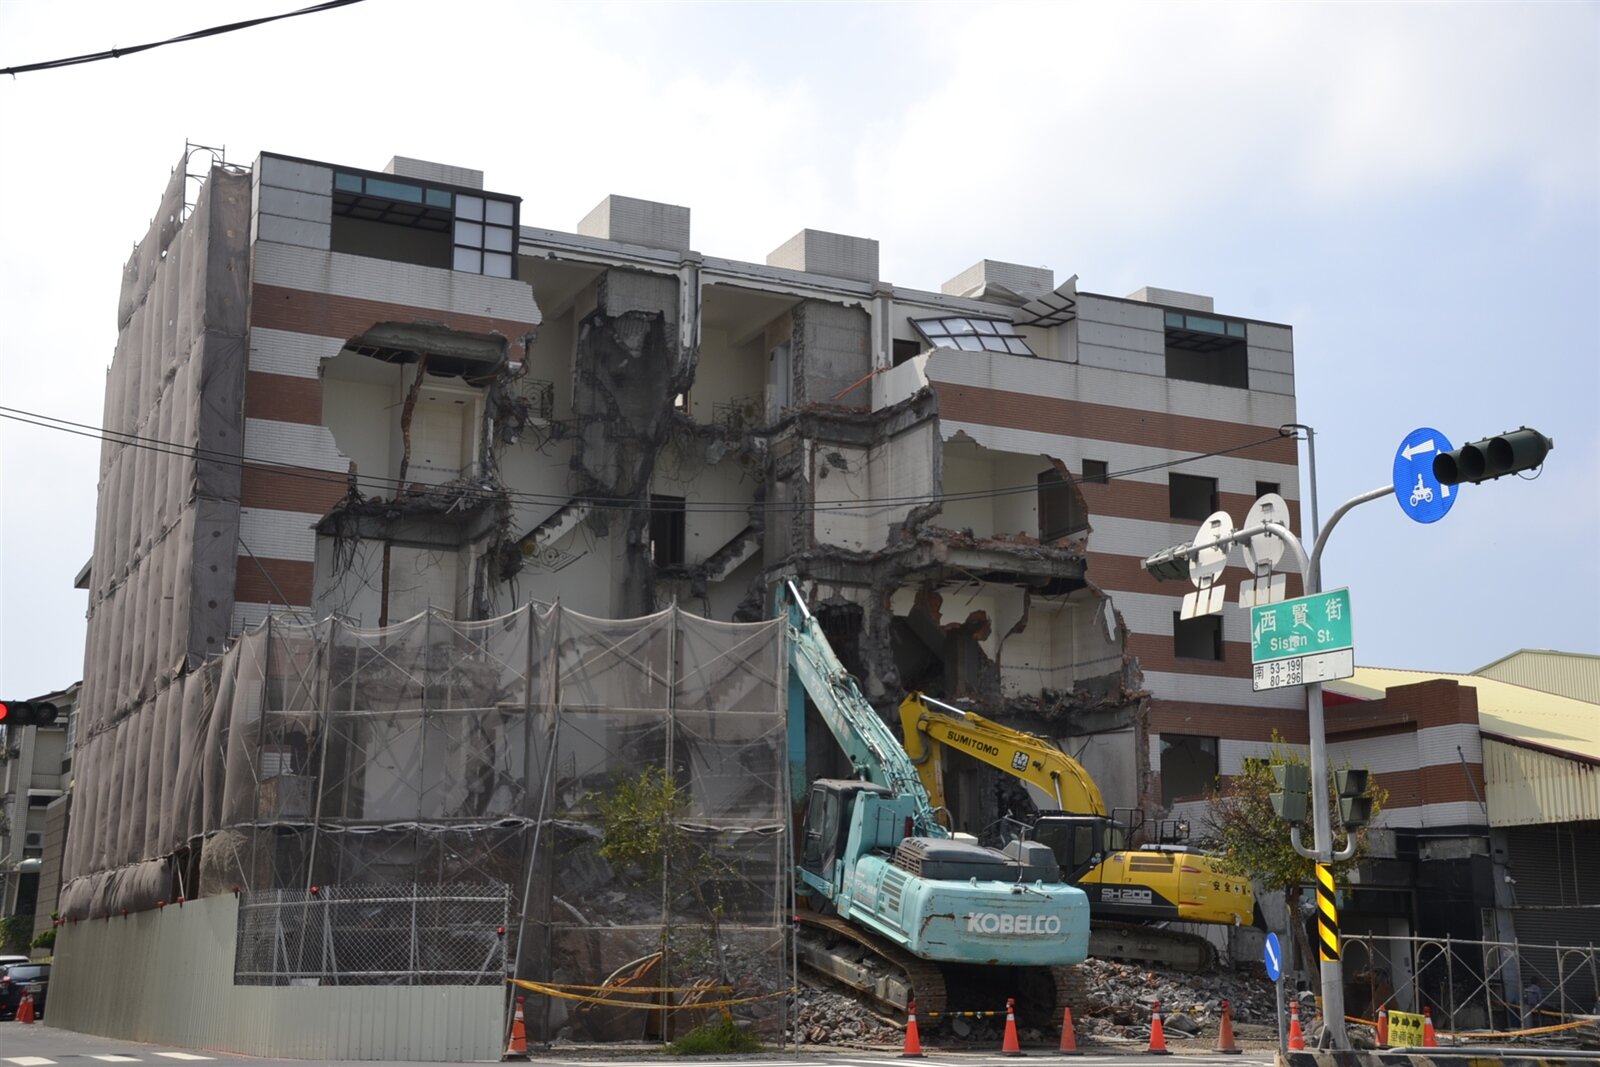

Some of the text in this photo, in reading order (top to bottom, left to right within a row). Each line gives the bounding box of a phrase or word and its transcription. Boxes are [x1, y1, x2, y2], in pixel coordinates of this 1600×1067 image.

[1259, 598, 1342, 634] 西賢街
[1317, 629, 1334, 643] St.
[1255, 659, 1300, 680] 南 53-199
[1270, 672, 1300, 687] 80-296
[947, 731, 999, 756] SUMITOMO
[967, 912, 1061, 934] KOBELCO
